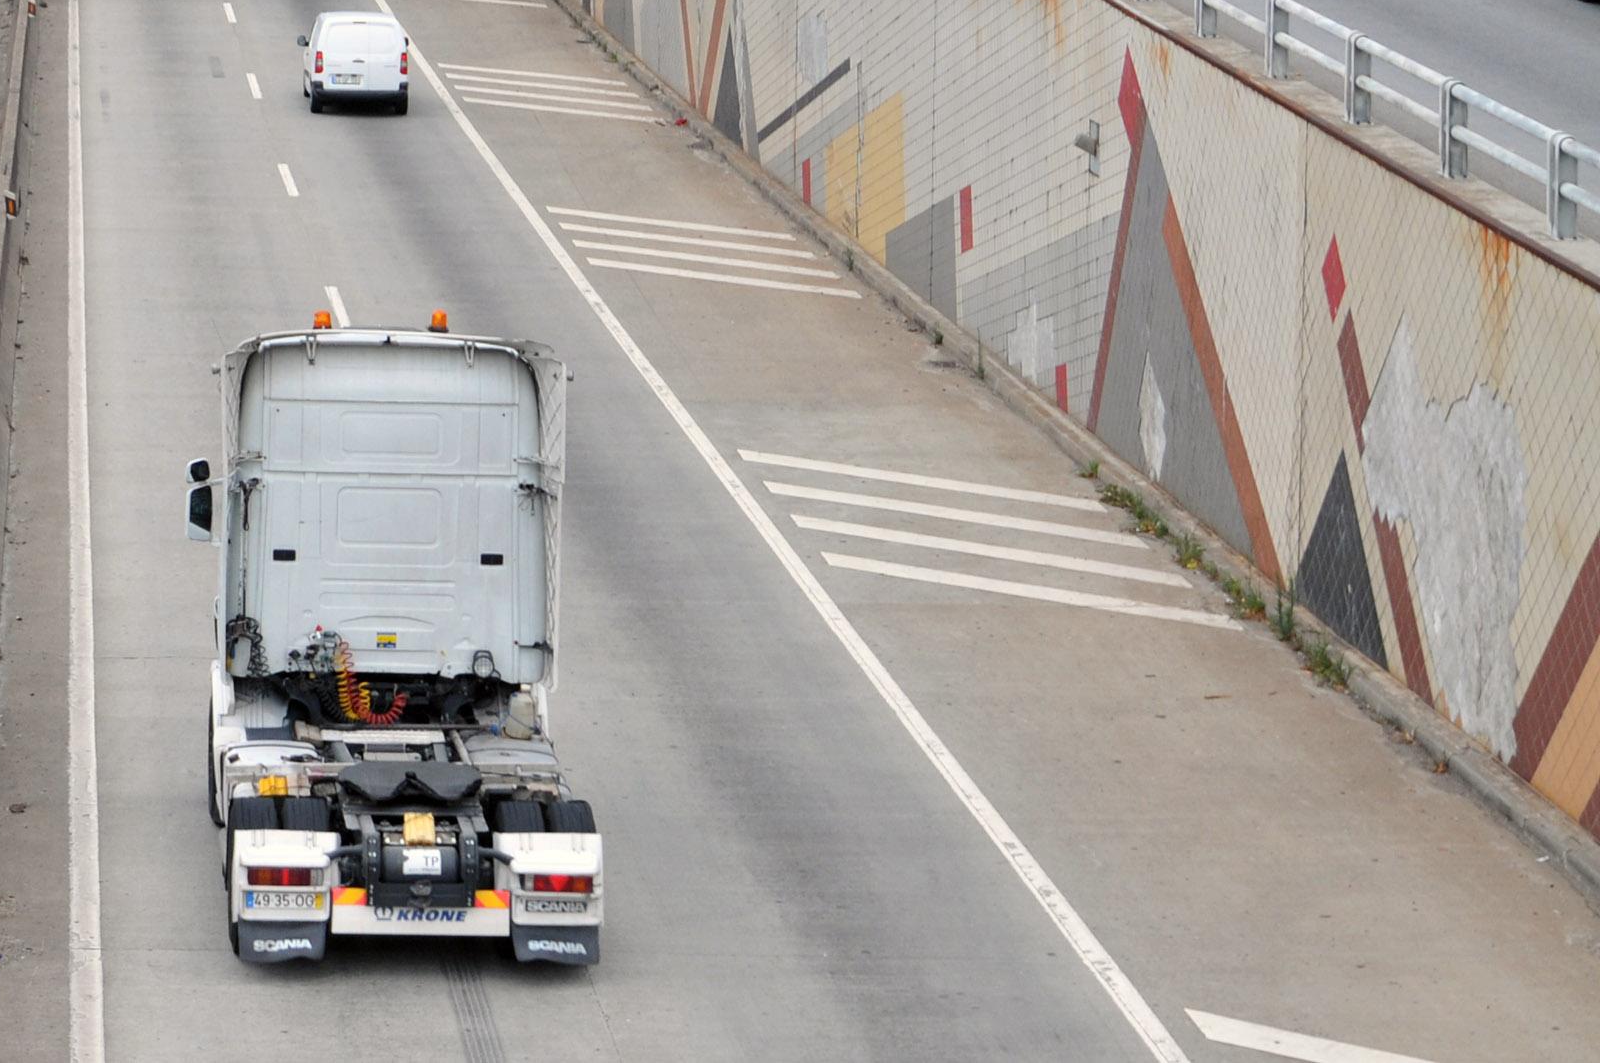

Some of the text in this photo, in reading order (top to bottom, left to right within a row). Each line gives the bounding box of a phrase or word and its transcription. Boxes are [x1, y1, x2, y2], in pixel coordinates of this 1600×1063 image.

[423, 856, 439, 867] TP
[527, 900, 587, 913] SCANIA
[397, 909, 467, 922] KRONE
[253, 938, 312, 952] SCANIA
[528, 939, 587, 955] SCANIA
